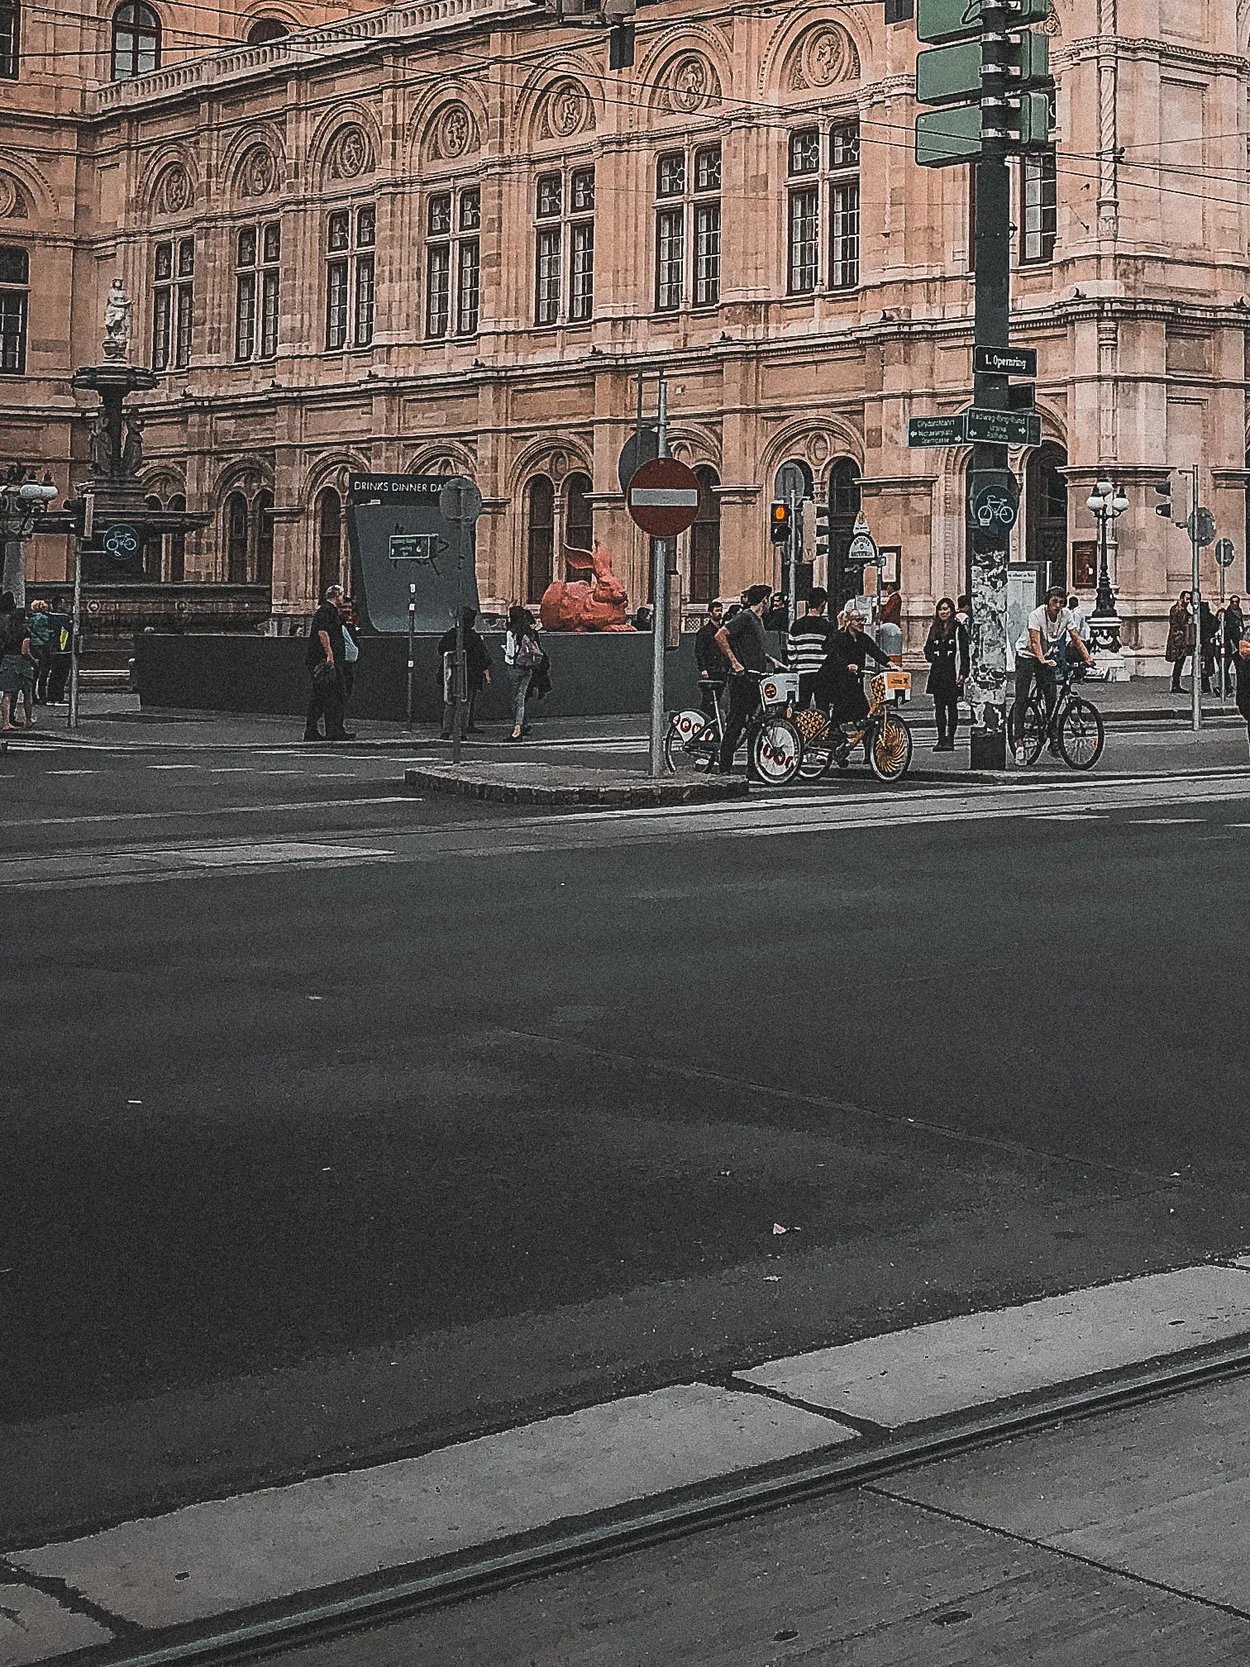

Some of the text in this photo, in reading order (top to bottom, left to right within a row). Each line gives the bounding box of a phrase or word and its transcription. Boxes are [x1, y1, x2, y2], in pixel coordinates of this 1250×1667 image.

[354, 481, 444, 493] DRINKS DINNER DA
